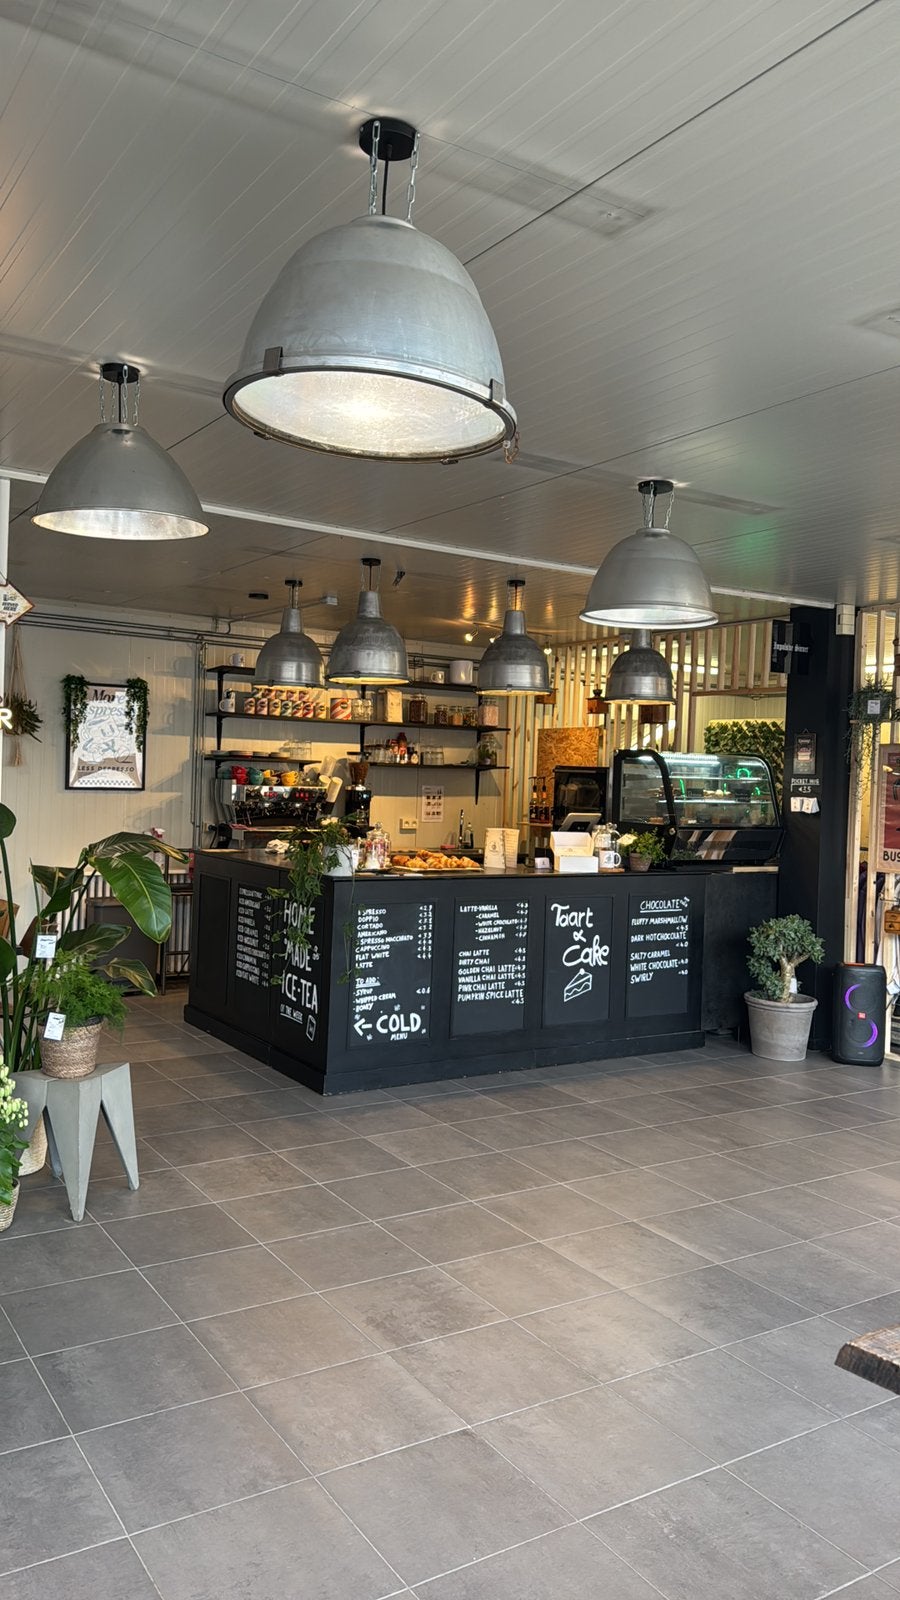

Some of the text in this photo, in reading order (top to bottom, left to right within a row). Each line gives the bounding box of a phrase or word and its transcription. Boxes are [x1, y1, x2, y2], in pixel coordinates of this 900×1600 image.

[92, 689, 126, 704] More
[640, 899, 680, 910] CHOCOLATE
[284, 900, 316, 934] HOME
[551, 903, 594, 928] Taart
[632, 915, 688, 926] FLUFFY MARSHMALLOW
[631, 931, 687, 943] DARK HOT CHOCOLATE
[355, 945, 390, 953] CAPPUCCINO
[562, 935, 610, 967] Cake
[285, 940, 312, 971] MADE
[356, 953, 369, 961] FLAT
[371, 951, 390, 959] WHITE
[630, 950, 670, 960] SALTY CARAMEL
[356, 961, 373, 969] LATTE
[458, 967, 480, 975] GOLDEN
[481, 965, 496, 973] CHAI
[498, 964, 515, 972] LATTE
[630, 962, 647, 971] WHITE
[648, 959, 678, 969] CHOCOLATE
[458, 975, 481, 983] VANILLA
[482, 973, 497, 981] CHAI
[498, 972, 515, 980] LATTE
[630, 972, 653, 984] SWIRLY
[458, 984, 472, 992] PINK
[473, 983, 487, 991] CHAI
[488, 982, 505, 990] LATTE
[458, 989, 524, 1002] PUMPKIN SPICE LATTE
[376, 1012, 421, 1034] COLD
[390, 1032, 408, 1041] MENU
